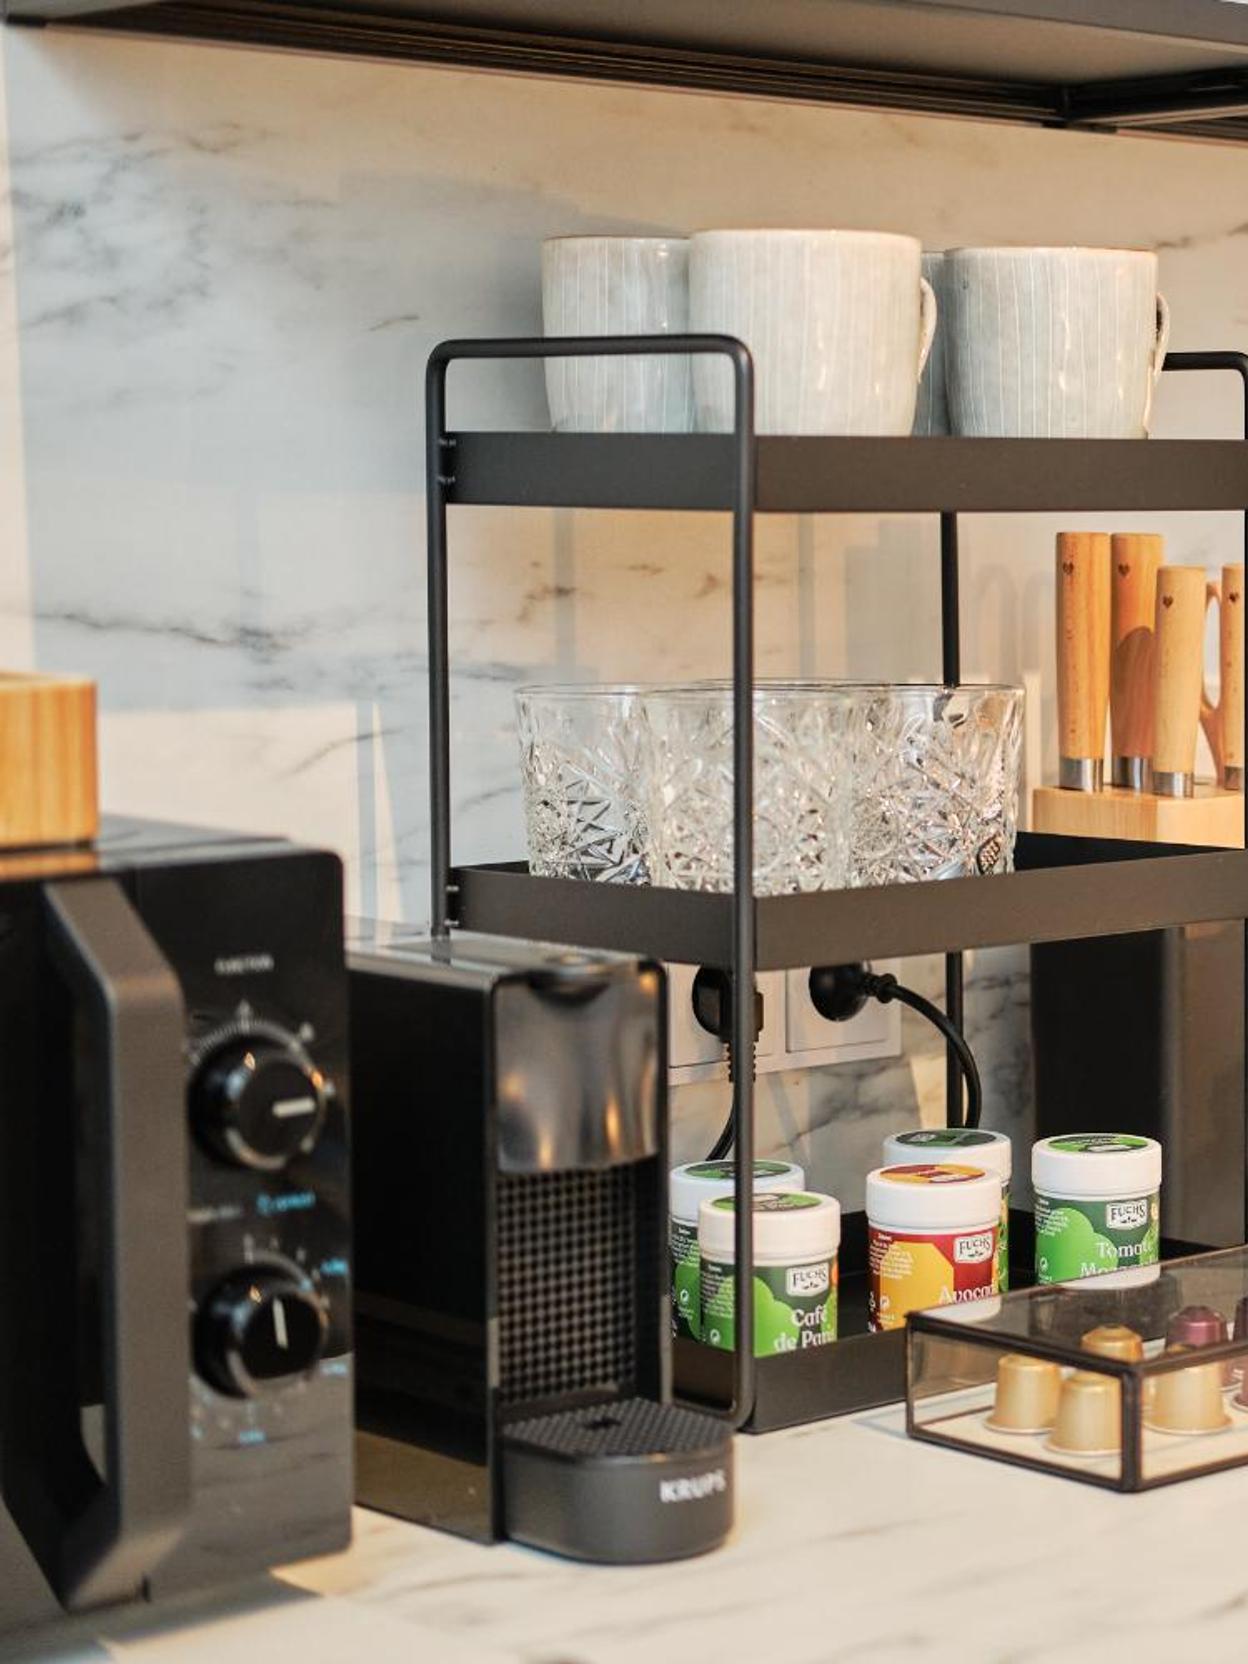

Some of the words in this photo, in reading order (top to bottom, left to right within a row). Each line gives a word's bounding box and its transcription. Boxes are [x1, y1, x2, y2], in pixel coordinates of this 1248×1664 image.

[1111, 1202, 1146, 1221] FUCHS
[959, 1237, 992, 1256] FUCHS
[792, 1267, 828, 1287] FUCHS
